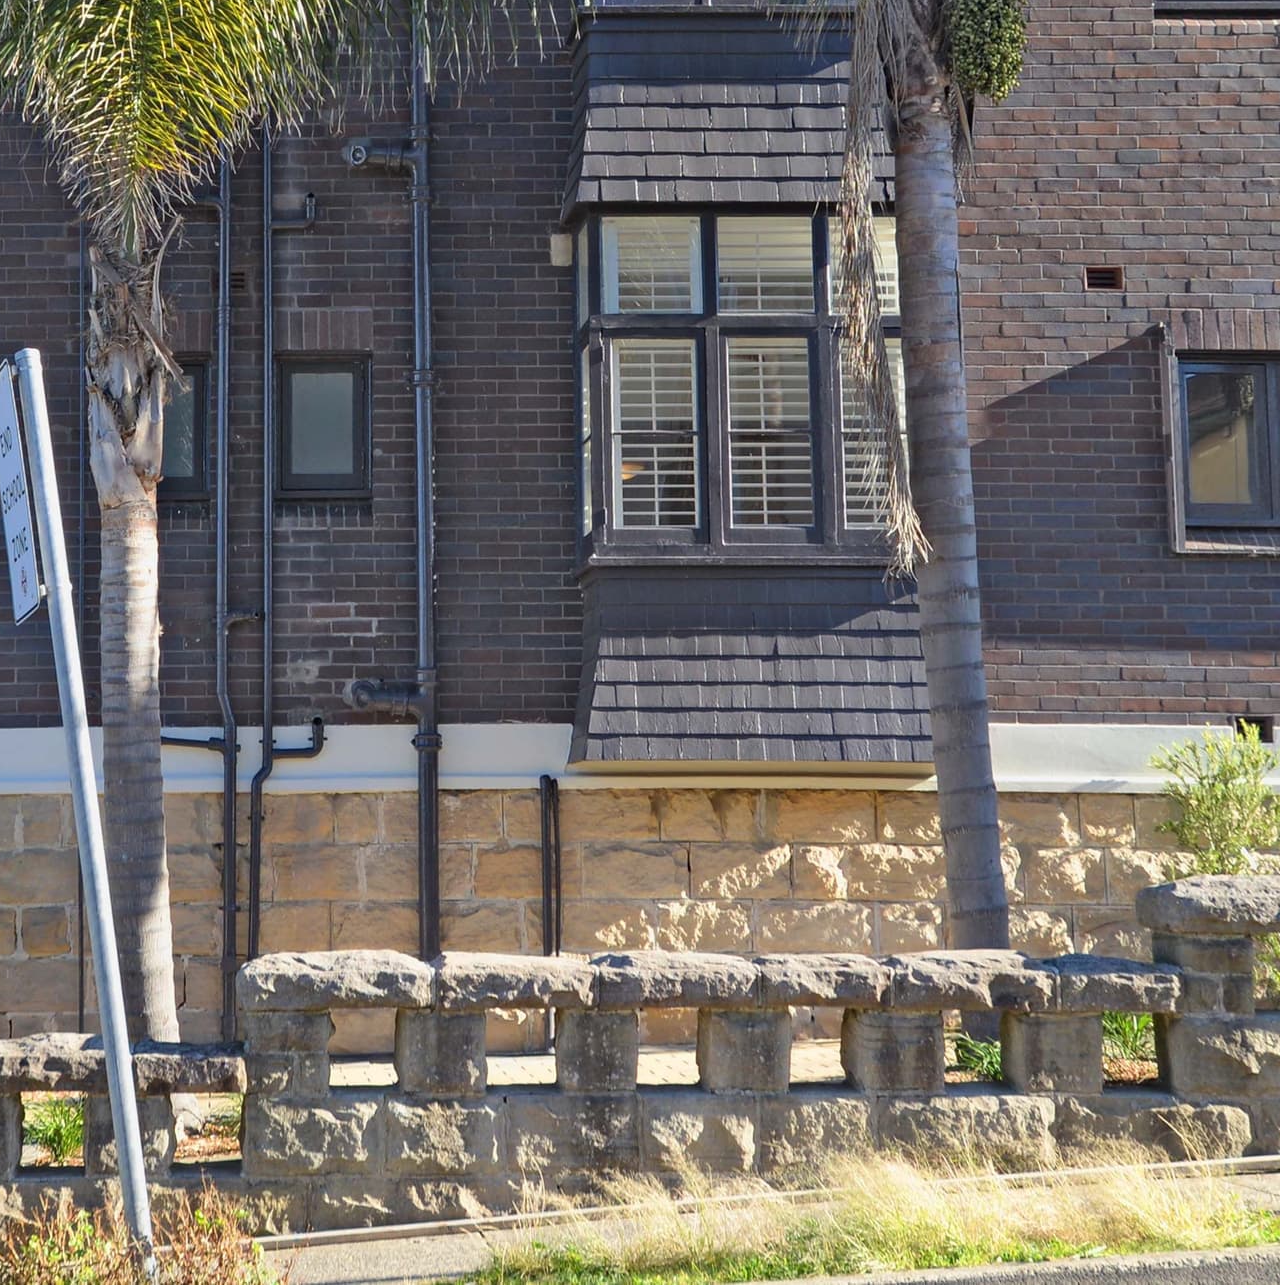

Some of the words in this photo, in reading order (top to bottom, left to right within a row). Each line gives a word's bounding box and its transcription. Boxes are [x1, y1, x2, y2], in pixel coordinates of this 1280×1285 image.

[0, 425, 12, 458] END
[2, 471, 25, 514] SCHOOL
[11, 526, 28, 562] ZONE
